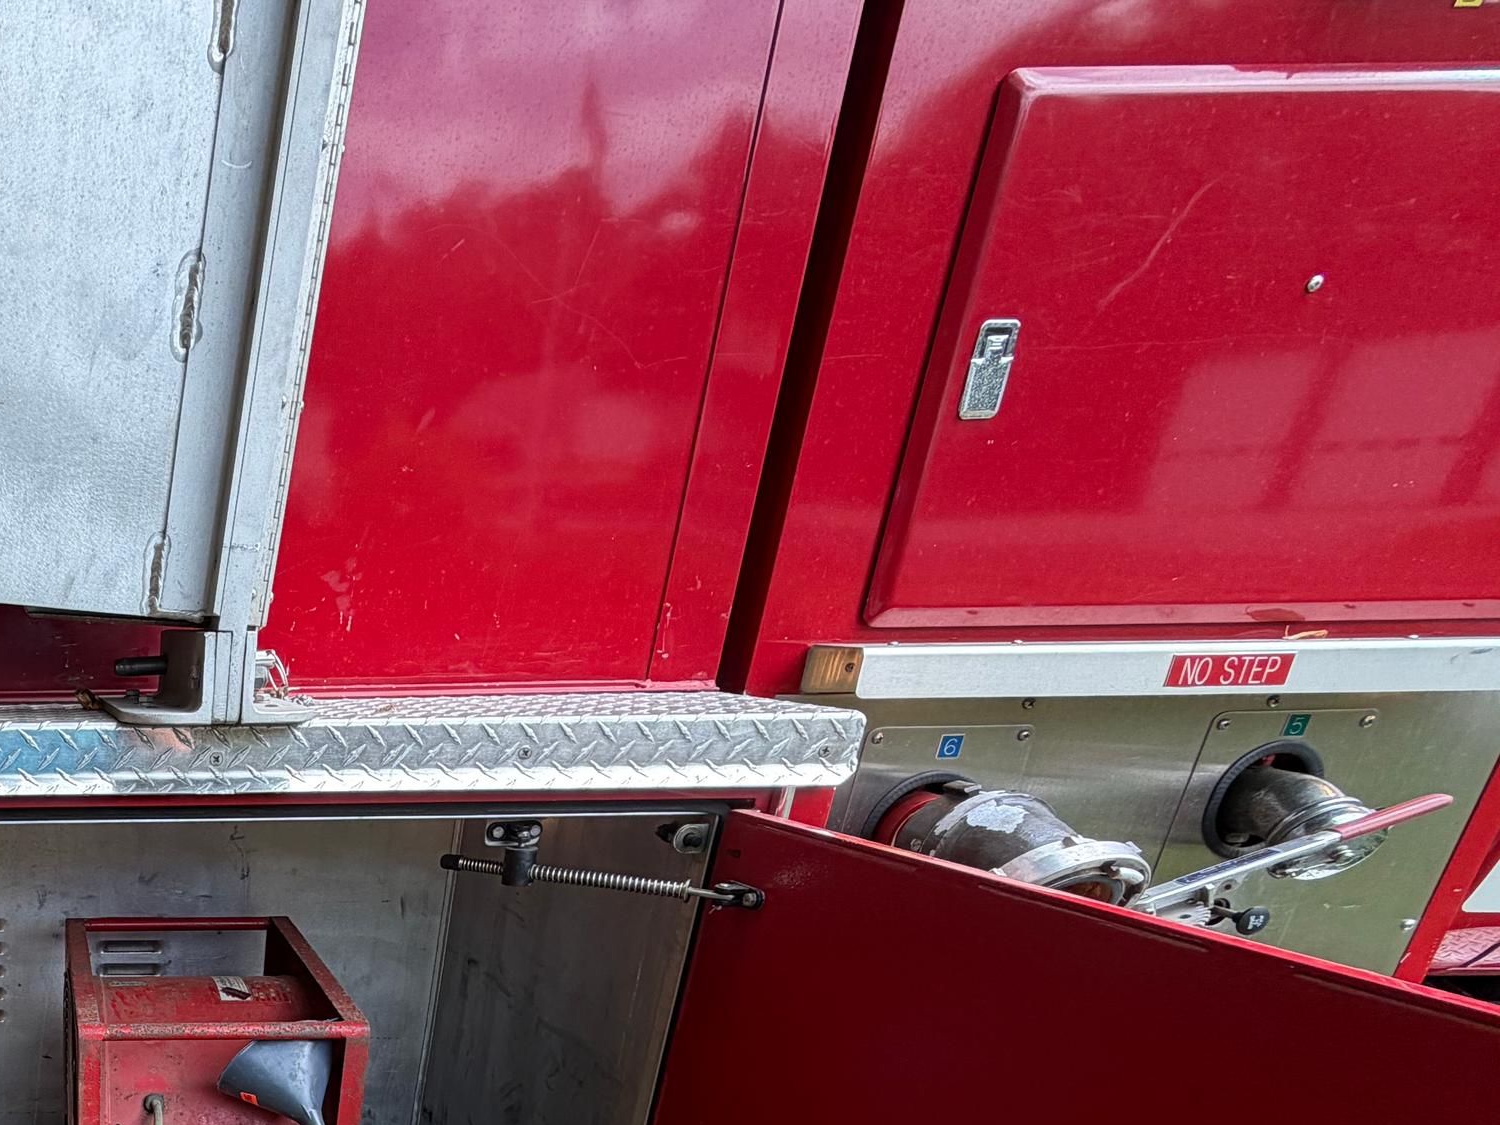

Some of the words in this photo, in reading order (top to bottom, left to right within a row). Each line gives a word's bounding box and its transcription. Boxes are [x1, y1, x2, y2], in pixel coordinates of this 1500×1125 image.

[1178, 656, 1213, 685] NO
[1219, 655, 1282, 685] STEP
[1289, 717, 1305, 735] 5
[944, 738, 958, 755] 6
